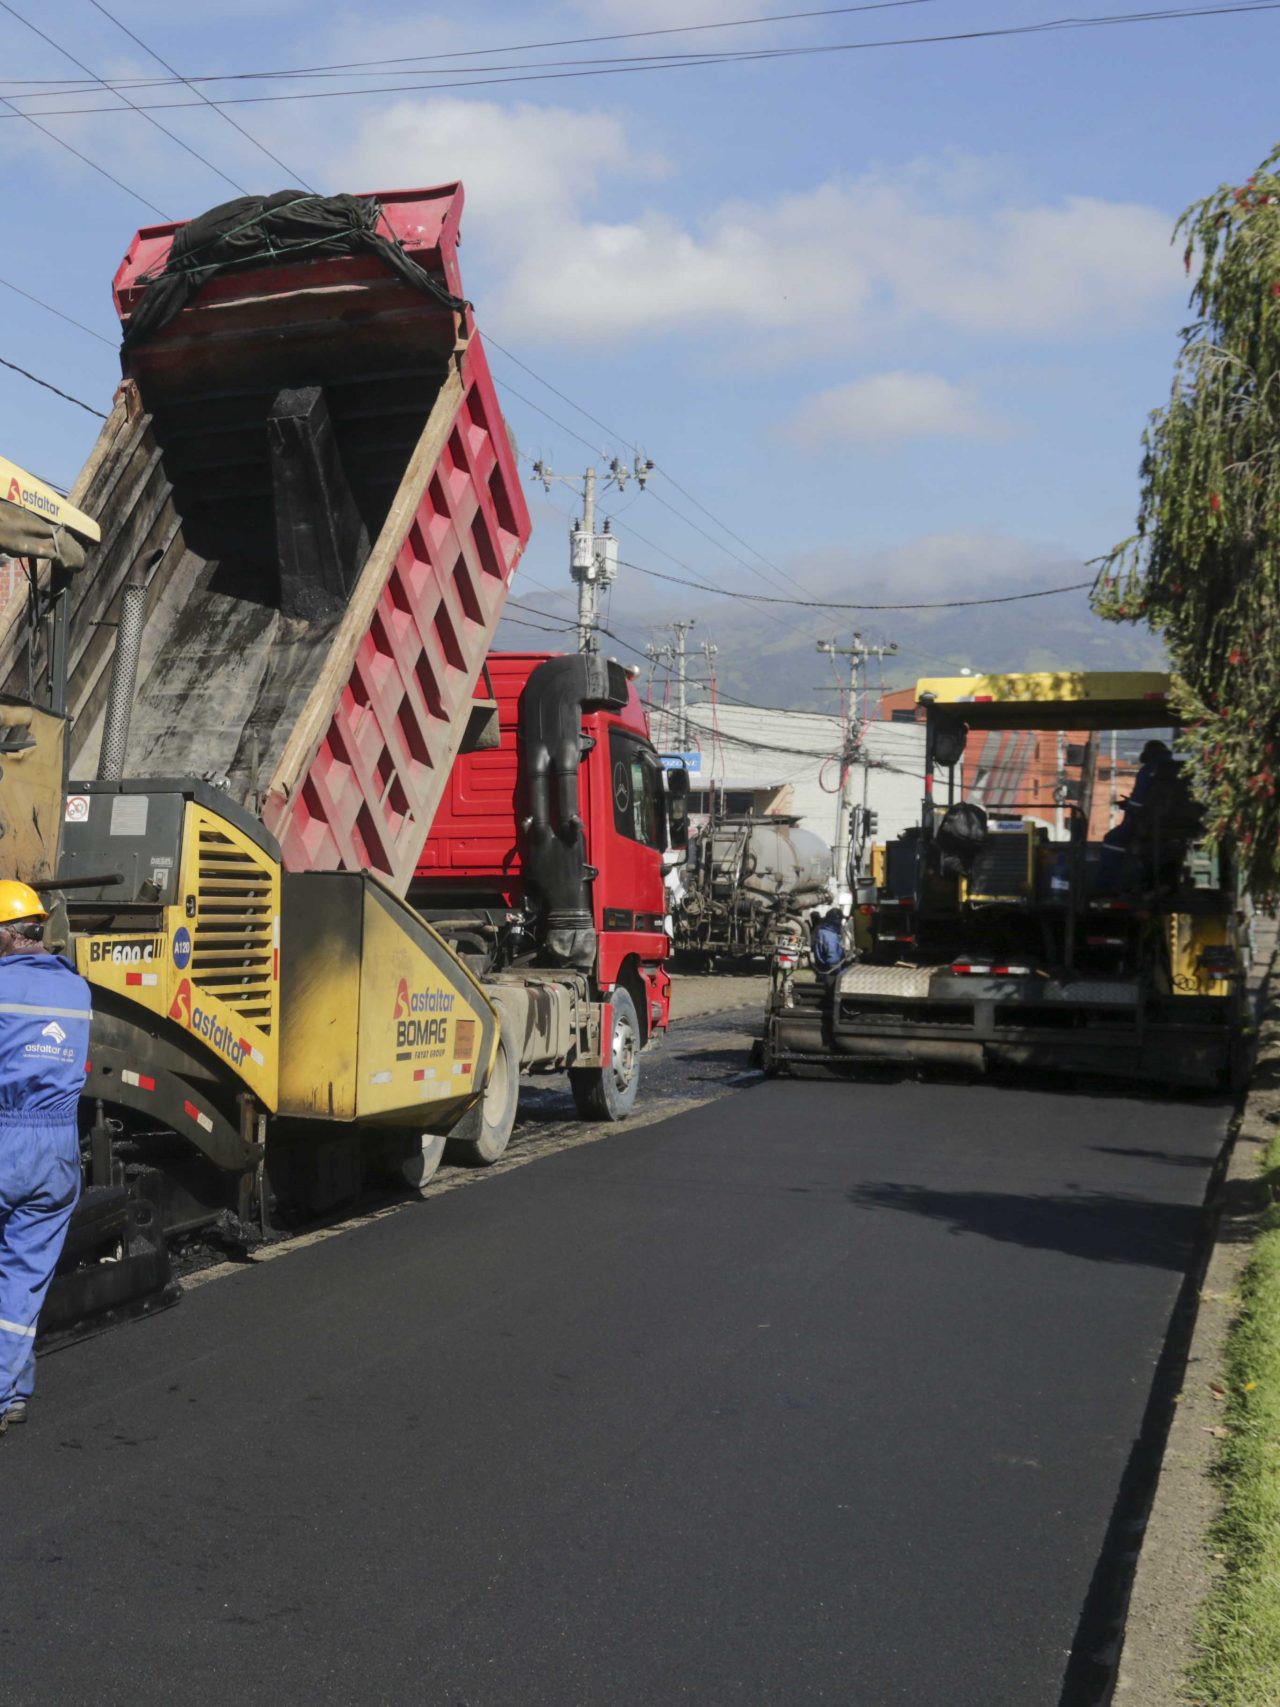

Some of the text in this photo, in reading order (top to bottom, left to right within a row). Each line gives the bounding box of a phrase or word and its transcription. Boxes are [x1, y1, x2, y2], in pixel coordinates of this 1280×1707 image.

[22, 490, 60, 517] asfaltar
[174, 942, 190, 954] A120
[411, 987, 455, 1012] asfaltar
[192, 1007, 247, 1067] asfaltar
[396, 1017, 448, 1048] BOMAG
[25, 1044, 61, 1055] asfaltar
